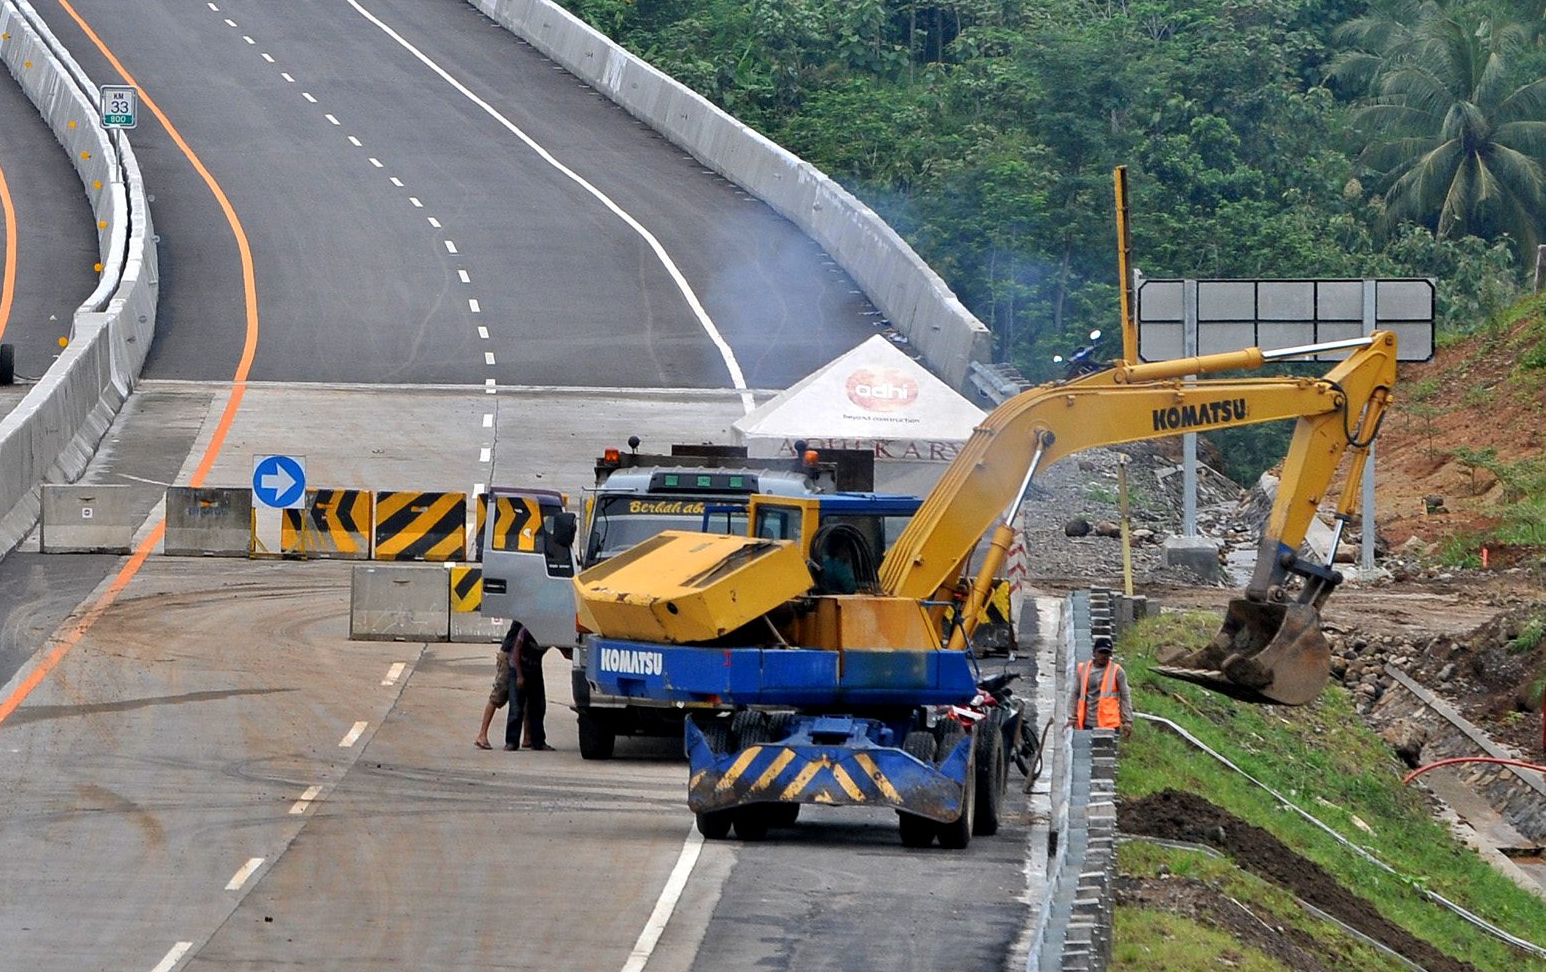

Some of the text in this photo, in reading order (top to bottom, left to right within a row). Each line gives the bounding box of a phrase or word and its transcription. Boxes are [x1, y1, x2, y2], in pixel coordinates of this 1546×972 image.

[111, 101, 129, 113] 33
[855, 383, 908, 399] adhi
[1152, 398, 1246, 431] KOMATSU
[874, 439, 965, 461] KARY
[630, 500, 681, 514] Berkah
[601, 648, 663, 675] KOMATSU
